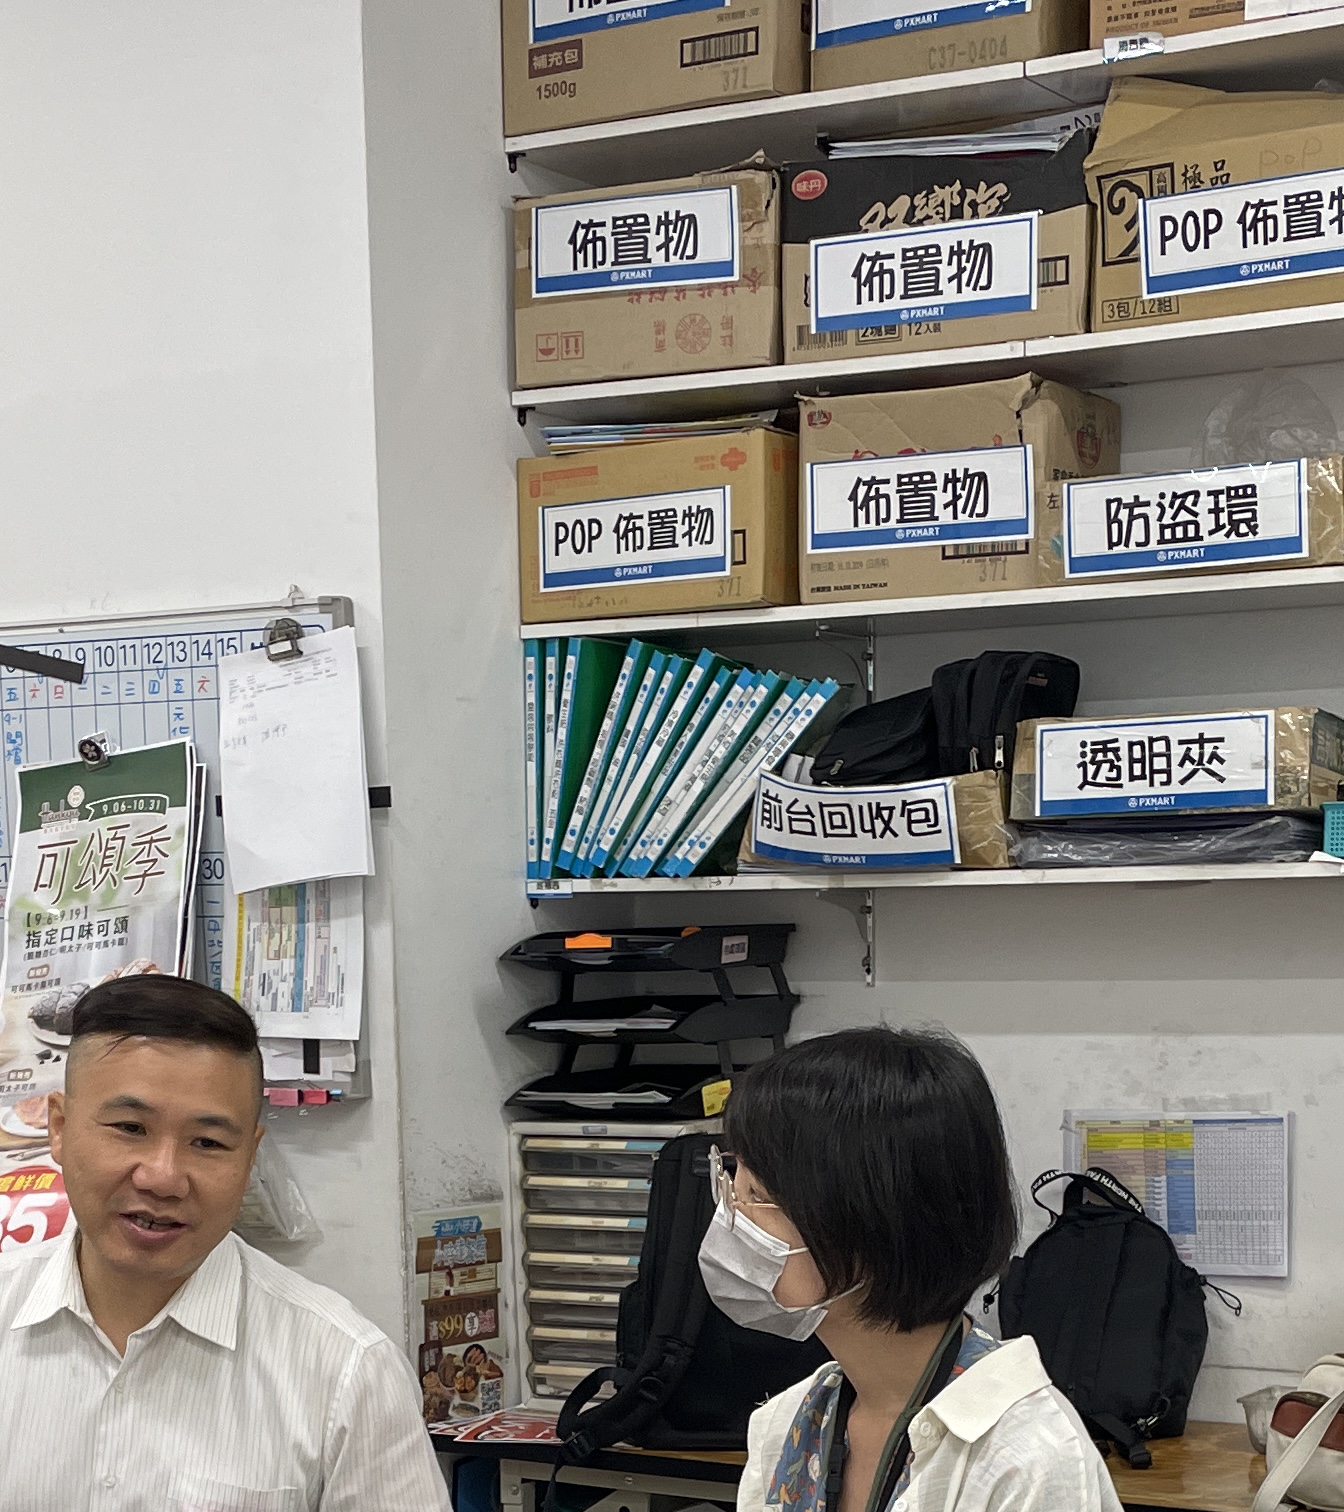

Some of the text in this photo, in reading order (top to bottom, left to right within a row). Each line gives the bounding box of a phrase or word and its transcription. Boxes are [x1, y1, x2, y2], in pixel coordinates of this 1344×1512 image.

[615, 8, 648, 22] PXMART
[904, 12, 938, 28] PXMART
[532, 48, 579, 70] 補充包
[536, 80, 577, 100] 1500g
[1182, 158, 1231, 188] 極品
[568, 209, 699, 271] 佈置物
[1159, 209, 1223, 256] POP
[620, 269, 652, 281] PXMART
[851, 239, 994, 305] 佈置物
[1251, 259, 1290, 275] PXMART
[910, 305, 945, 318] PXMART
[847, 467, 990, 528] 佈置物
[1106, 483, 1259, 550] 防盜環
[554, 504, 715, 556] POP 佈置物
[906, 527, 940, 538] PXMART
[1167, 548, 1205, 560] PXMART
[623, 565, 653, 576] PXMART
[94, 645, 115, 668] 10
[119, 643, 137, 666] 11
[143, 642, 164, 664] 12
[167, 640, 188, 663] 13
[192, 638, 213, 662] 14
[217, 637, 238, 656] 15
[5, 687, 19, 702] 五
[173, 678, 186, 694] 五
[197, 675, 210, 694] 六
[1077, 732, 1228, 791] 透明夾
[102, 799, 162, 815] 9.06-10.31
[1139, 795, 1175, 807] PXMART
[759, 788, 942, 839] 前台回收包
[32, 822, 172, 906] 可頌季
[201, 858, 224, 880] 30
[832, 853, 867, 866] PXMART
[25, 915, 130, 950] 指定口味可頌
[438, 1315, 464, 1340] $99
